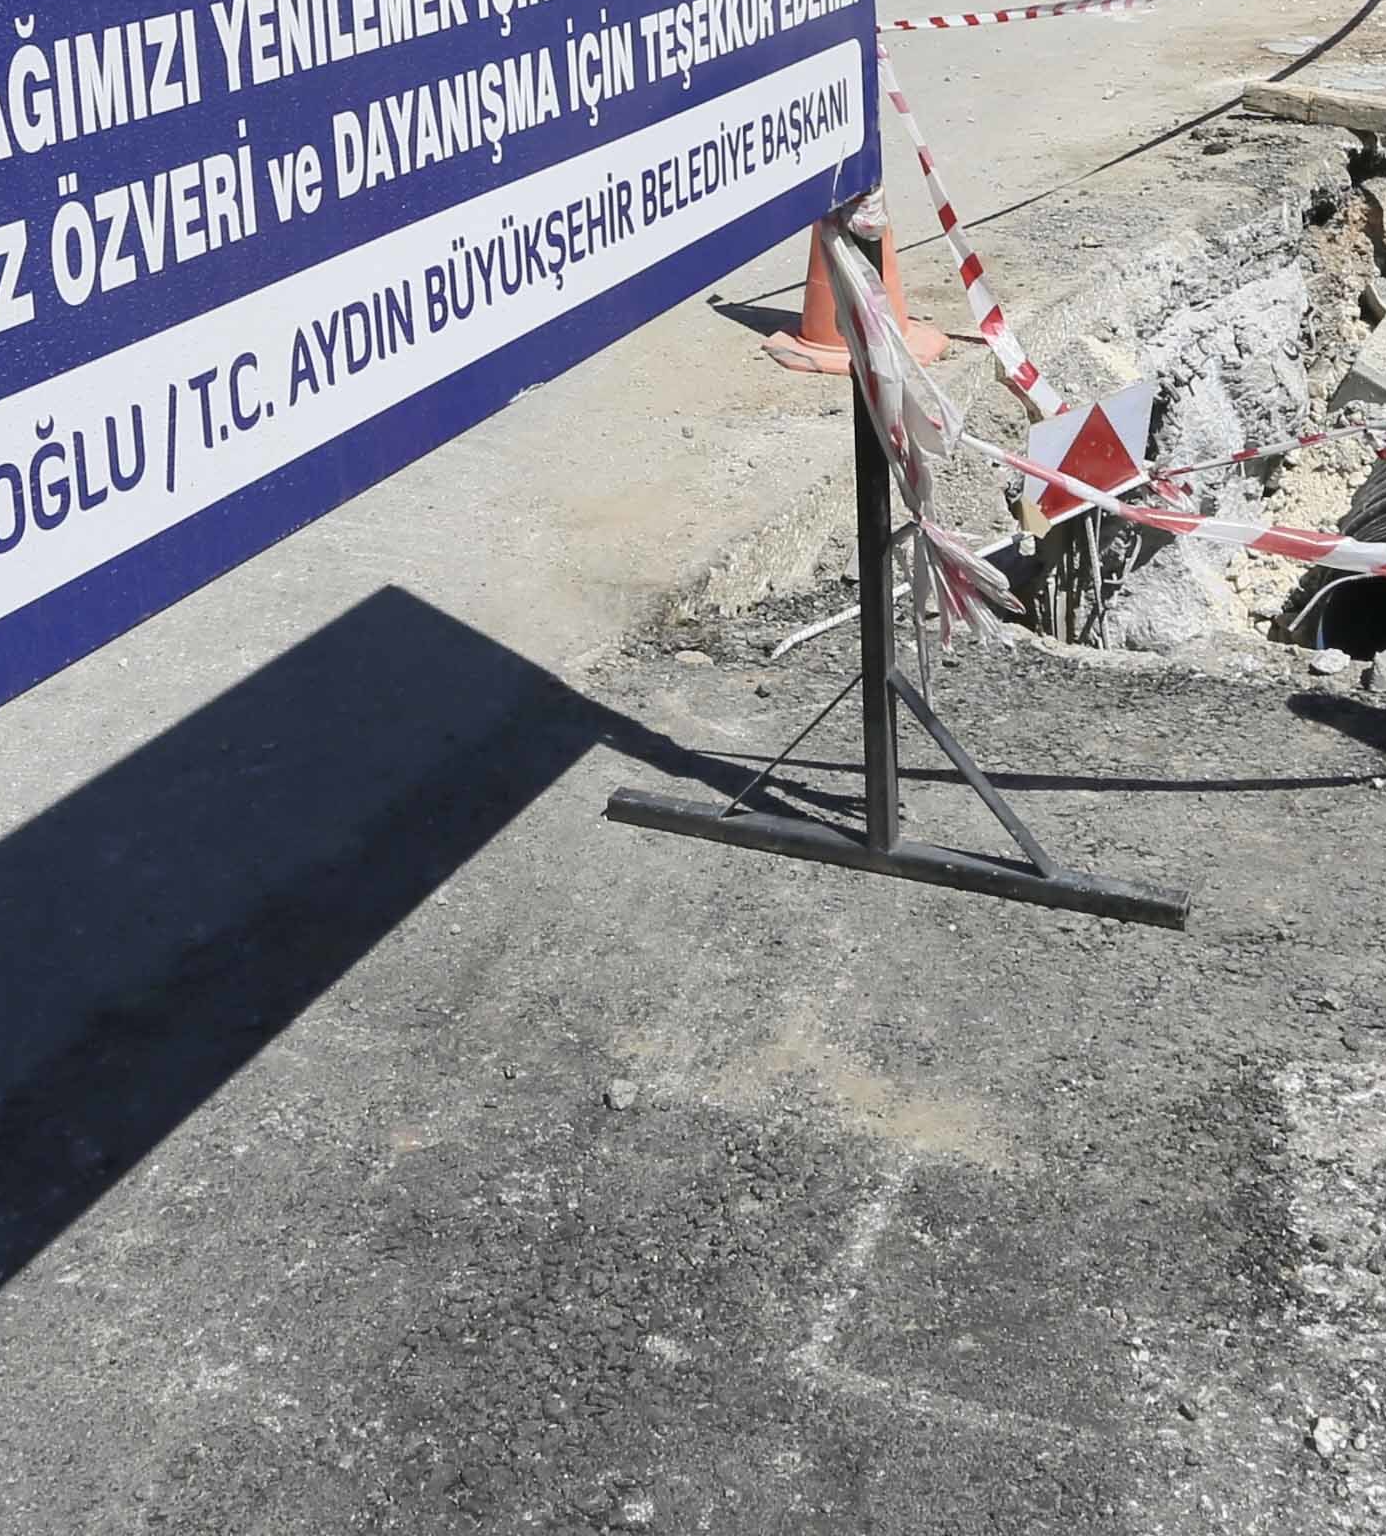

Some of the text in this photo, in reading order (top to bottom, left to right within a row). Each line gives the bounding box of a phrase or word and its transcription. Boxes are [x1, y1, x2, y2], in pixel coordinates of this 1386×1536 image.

[51, 118, 258, 307] ÖZVERİ
[269, 142, 322, 223] ve
[332, 44, 560, 197] DAYANIŞMA
[567, 8, 635, 127] İÇİN
[289, 278, 415, 407] AYDIN
[427, 172, 636, 336] BÜYÜKŞEHİR
[642, 119, 757, 229] BELEDİYE
[760, 77, 850, 169] BAŞKANI
